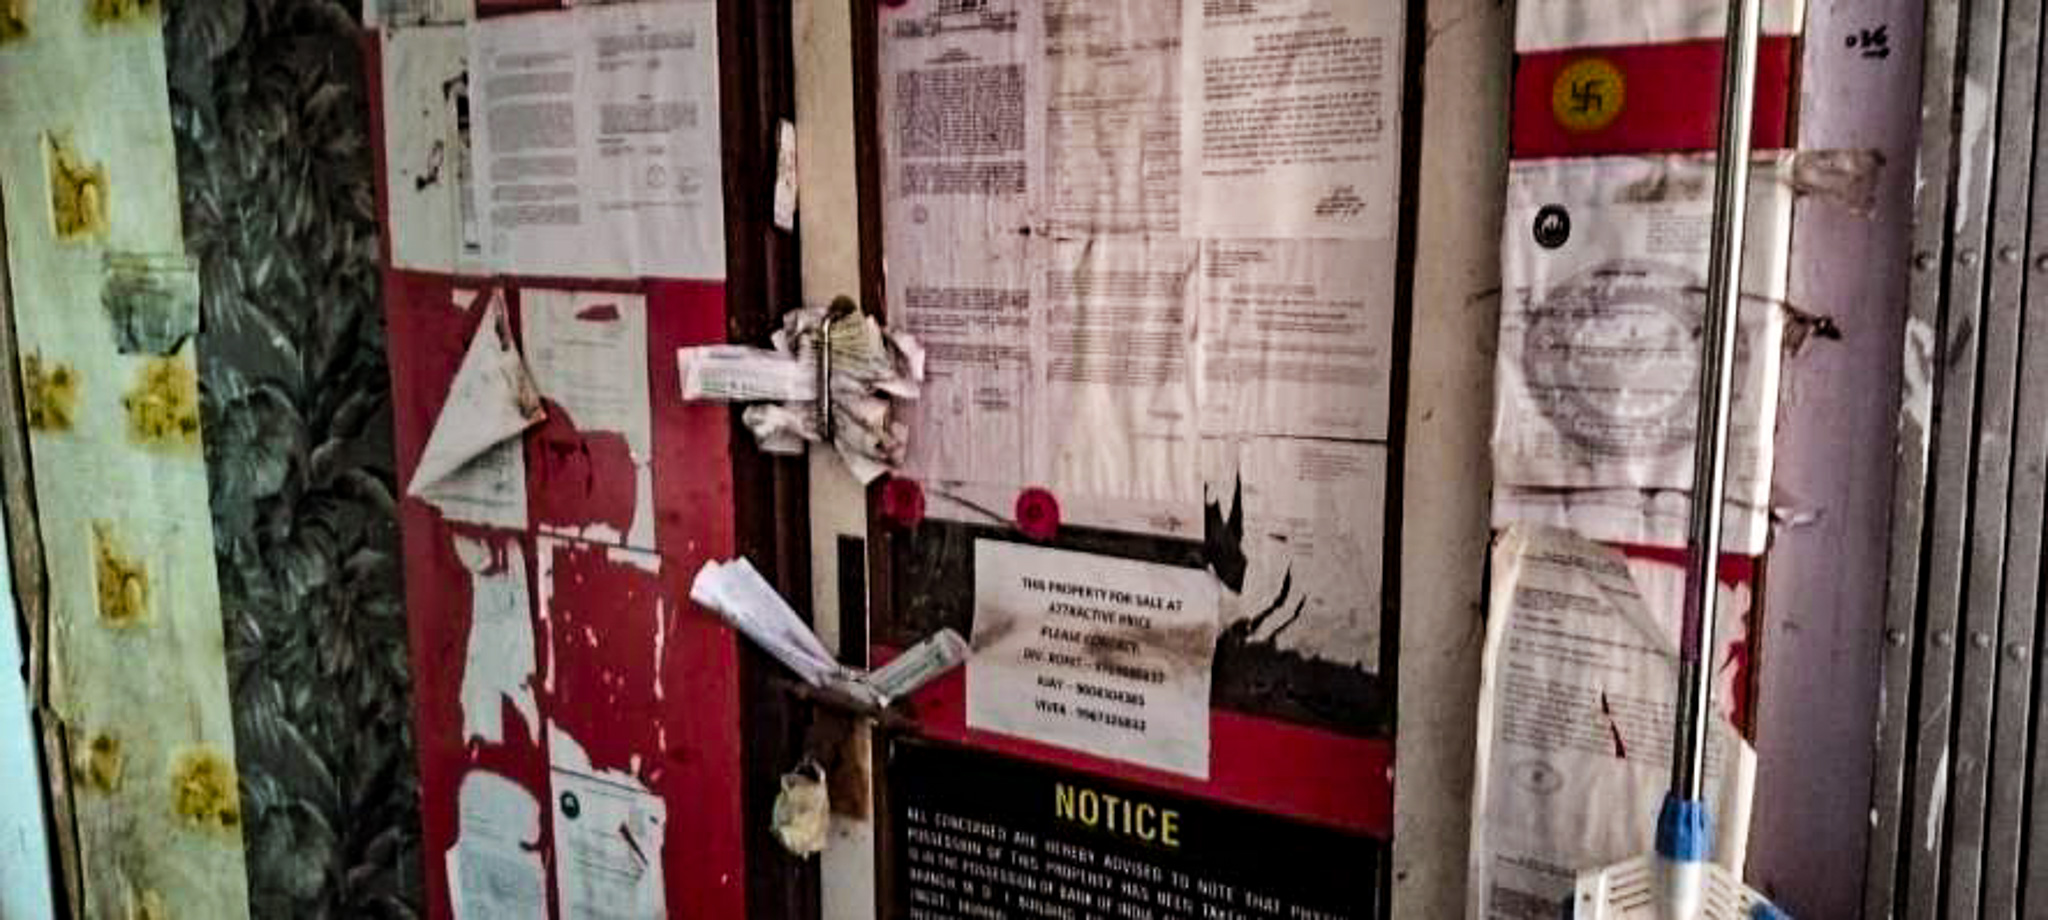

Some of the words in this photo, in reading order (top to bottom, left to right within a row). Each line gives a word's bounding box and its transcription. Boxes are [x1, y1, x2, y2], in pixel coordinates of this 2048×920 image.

[1022, 577, 1046, 591] THIS
[1049, 580, 1108, 600] PROPERTY
[1109, 591, 1133, 604] FOR
[1136, 594, 1163, 609] SALE
[1167, 599, 1183, 611] AT
[1049, 601, 1117, 622] ATTRACTIVE
[1119, 615, 1152, 629] PRICE
[1041, 625, 1081, 643] PLEASE
[1055, 782, 1181, 847] NOTICE
[908, 826, 981, 856] POSSESSION
[986, 845, 1003, 861] OF
[1011, 850, 1039, 870] THIS
[1045, 861, 1112, 889] PROPERTY
[1121, 881, 1150, 902] HAS
[1157, 890, 1193, 915] BEEN
[934, 812, 1007, 842] CONCERNED
[1013, 831, 1037, 849] ARE
[1045, 840, 1095, 864] HEREBY
[1103, 853, 1162, 883] ADVISED
[1171, 870, 1190, 889] TO
[1197, 877, 1233, 902] NOTE
[1245, 890, 1280, 914] THAT
[937, 852, 959, 870] THE
[962, 859, 1036, 891] POSSESSION
[1039, 879, 1053, 895] OF
[1060, 884, 1092, 906] BANK
[1097, 895, 1111, 912] OF
